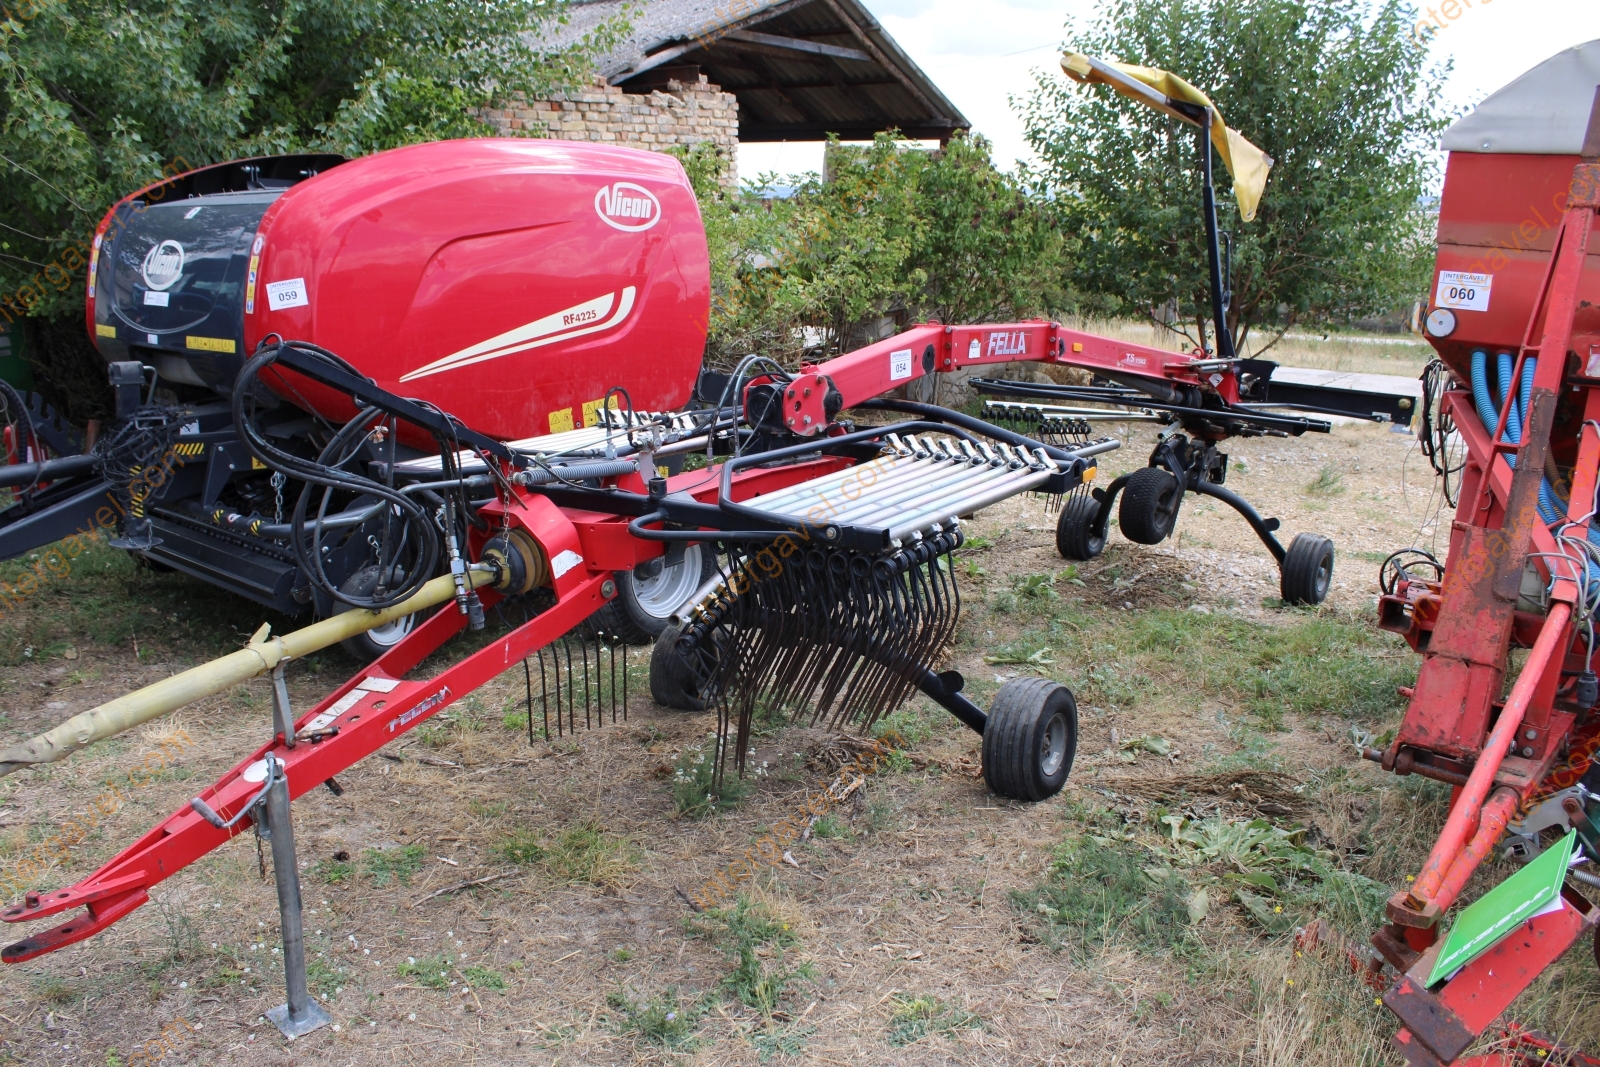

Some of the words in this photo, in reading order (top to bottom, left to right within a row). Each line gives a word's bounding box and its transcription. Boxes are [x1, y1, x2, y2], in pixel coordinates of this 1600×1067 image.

[602, 184, 653, 220] Vicon
[1445, 273, 1485, 282] INTERGAVEL
[278, 290, 298, 302] 059
[1450, 287, 1475, 301] 060
[563, 309, 597, 326] RF4225
[987, 331, 1026, 356] FELLA
[1125, 353, 1135, 363] TS
[895, 362, 907, 374] 054
